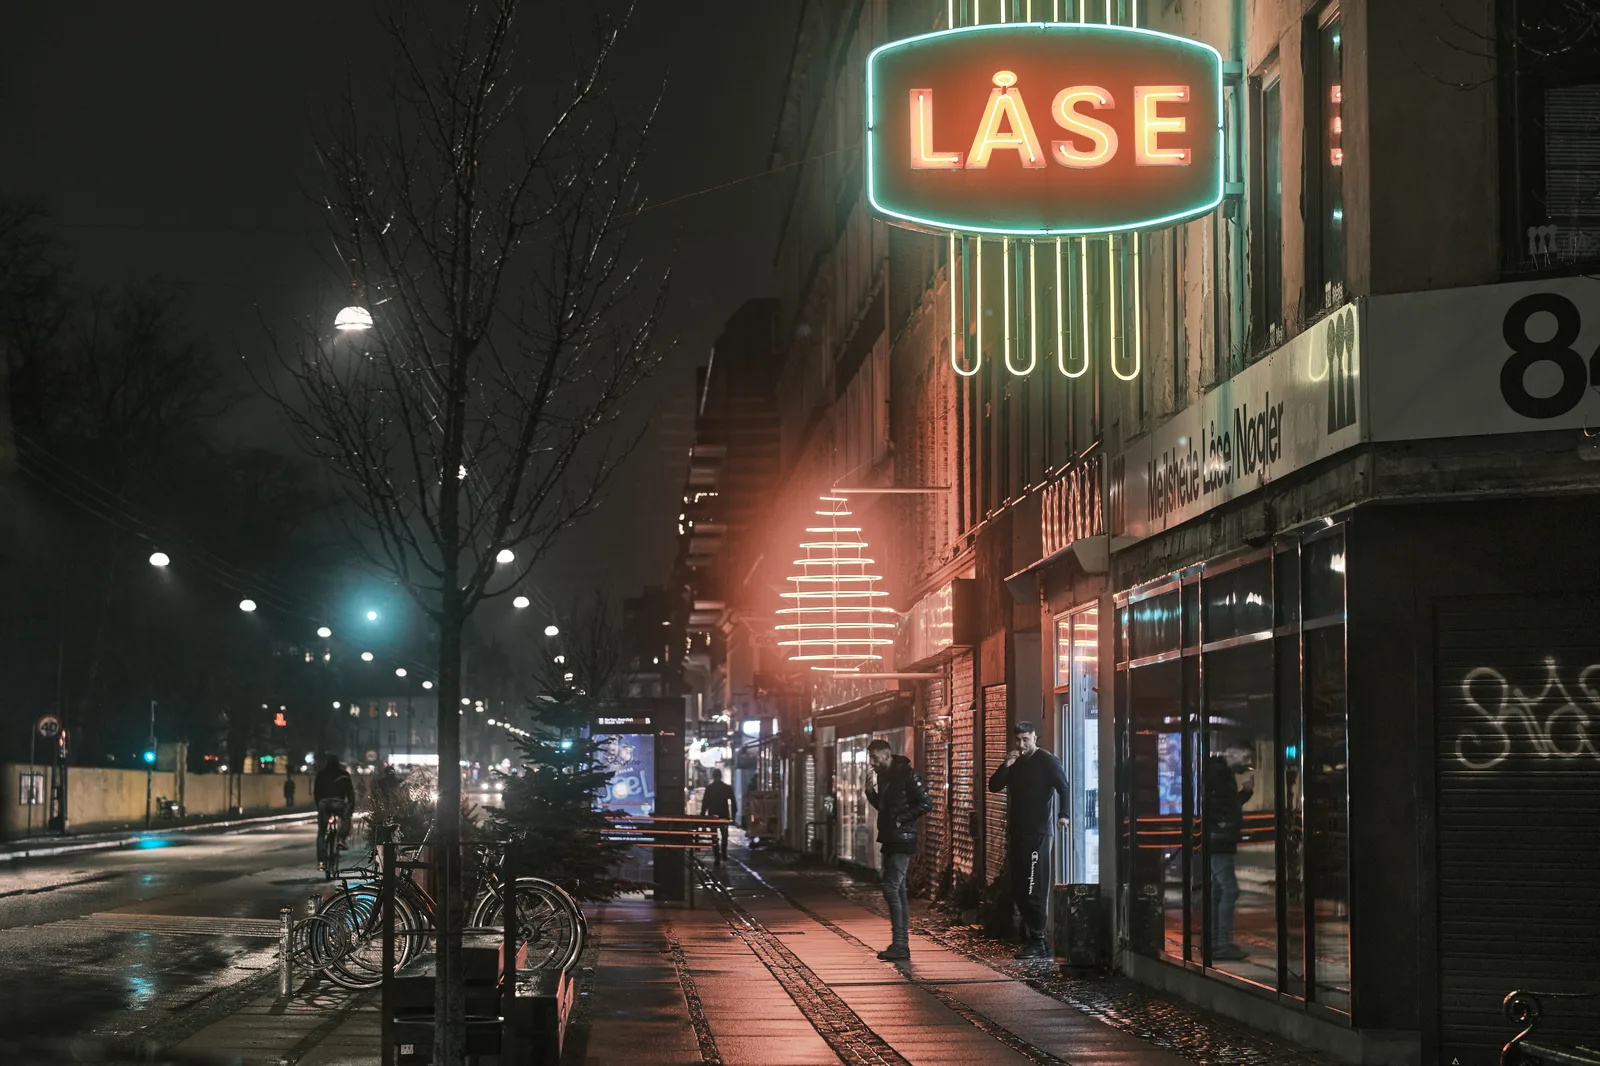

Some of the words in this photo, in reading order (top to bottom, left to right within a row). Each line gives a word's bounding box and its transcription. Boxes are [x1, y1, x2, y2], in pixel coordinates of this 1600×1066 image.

[910, 71, 1191, 169] LÅSE
[1500, 292, 1600, 419] 8
[1147, 437, 1200, 529] Mejlshede
[41, 722, 58, 733] 40
[1028, 850, 1039, 896] Champion
